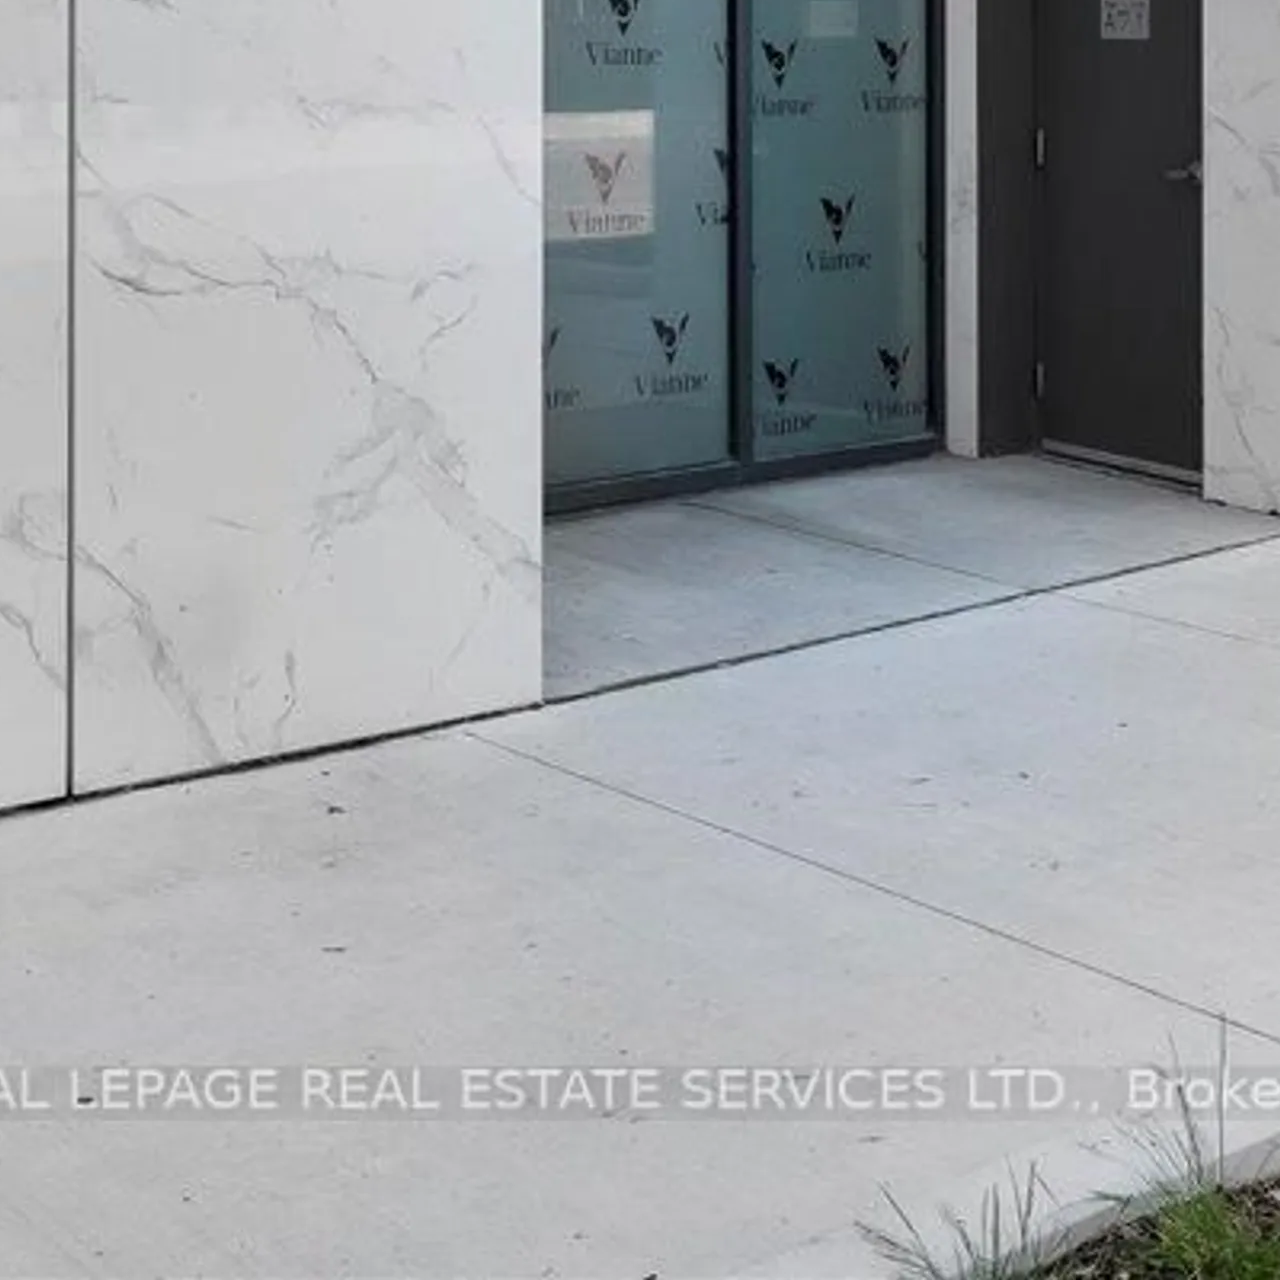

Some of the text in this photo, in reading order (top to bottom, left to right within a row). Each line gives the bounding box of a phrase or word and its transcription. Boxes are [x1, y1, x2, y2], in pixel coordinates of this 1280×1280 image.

[585, 40, 663, 68] Vianne
[805, 250, 873, 273] Vianne
[634, 370, 708, 398] Vianne
